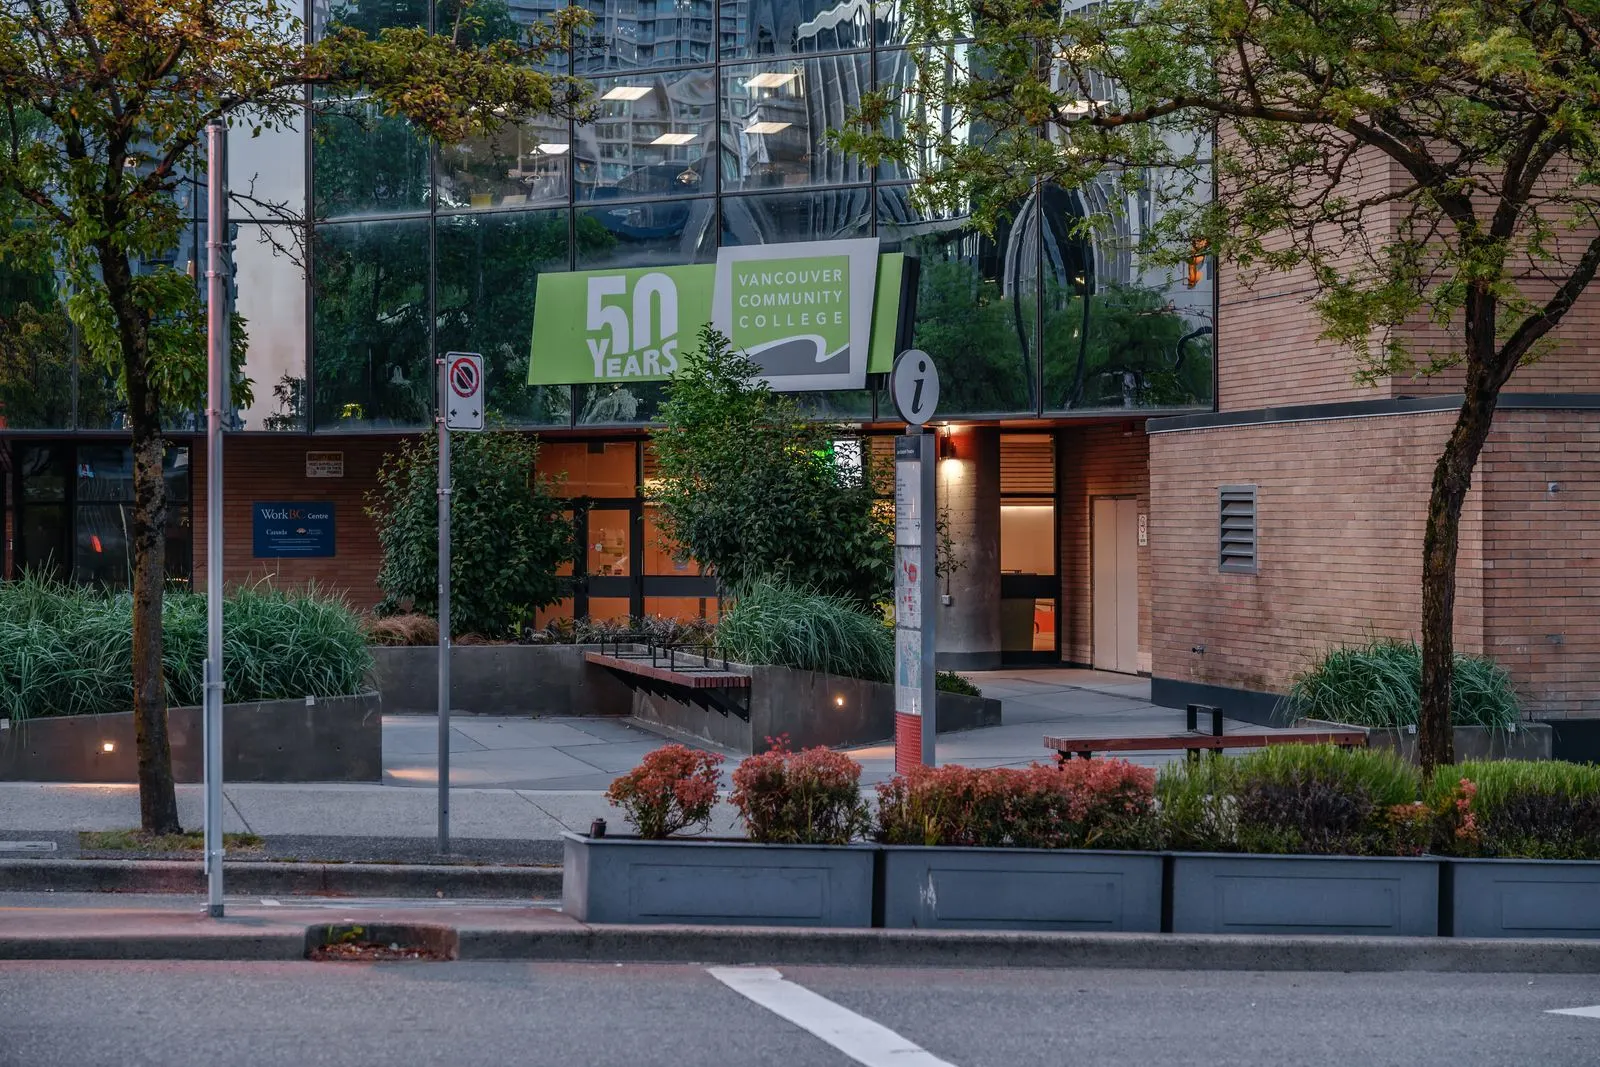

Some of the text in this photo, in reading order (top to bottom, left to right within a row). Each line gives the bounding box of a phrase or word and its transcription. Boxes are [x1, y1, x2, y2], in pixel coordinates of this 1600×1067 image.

[738, 269, 842, 287] VANCOUVER
[739, 290, 842, 308] COMMUNITY
[586, 272, 678, 355] 50
[739, 311, 842, 329] COLLEGE
[586, 338, 678, 378] YEARS
[307, 512, 329, 520] Centre
